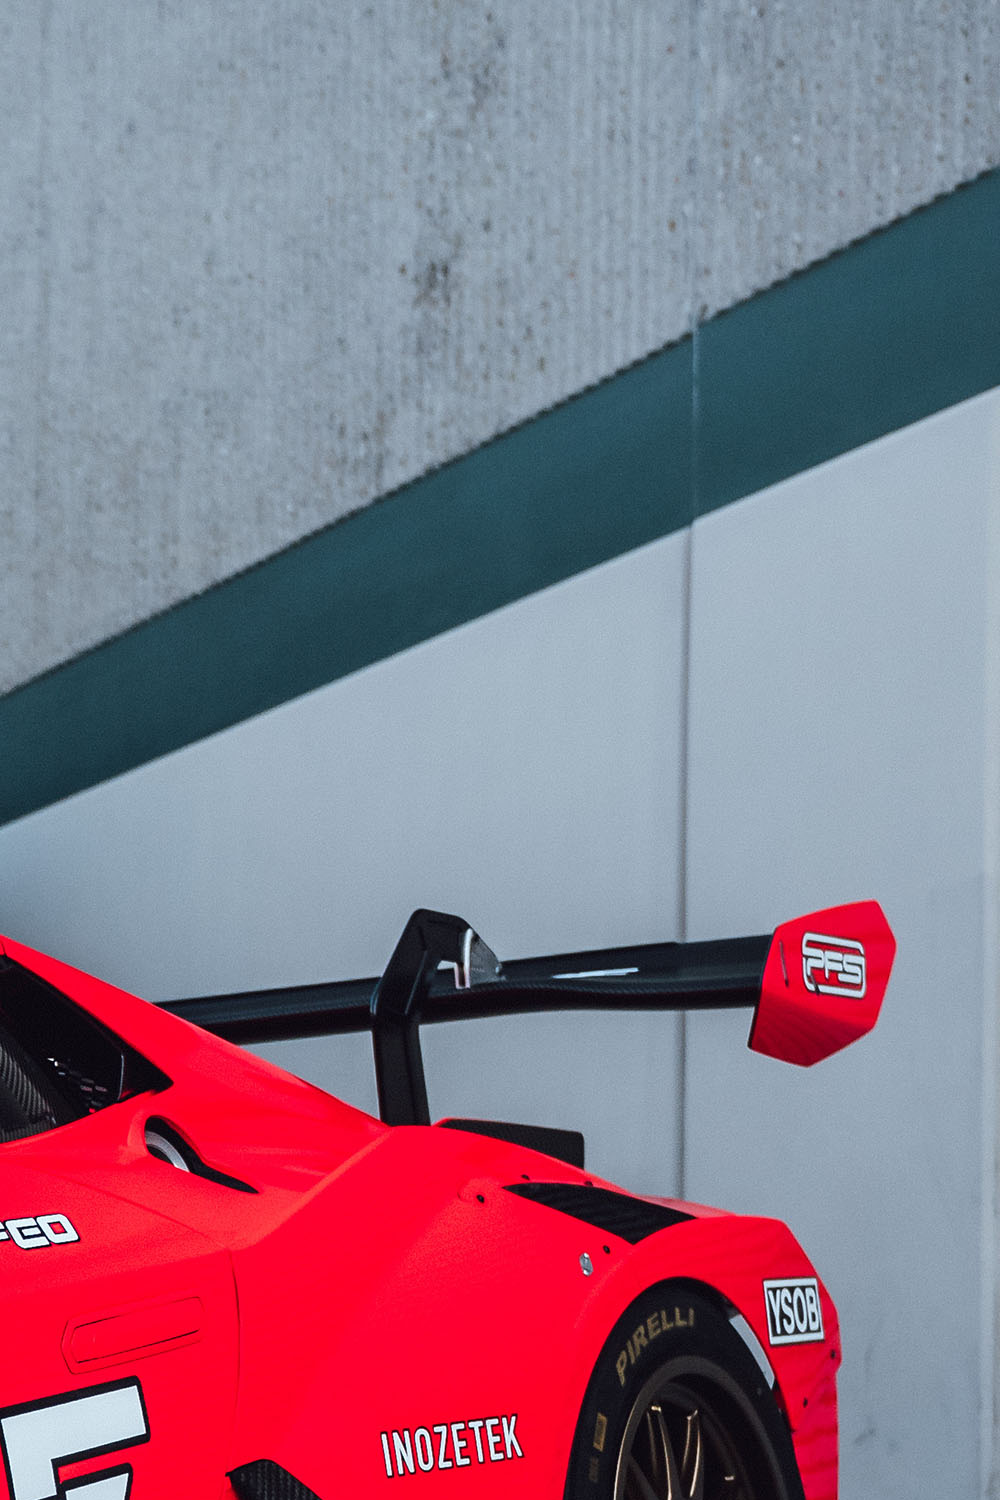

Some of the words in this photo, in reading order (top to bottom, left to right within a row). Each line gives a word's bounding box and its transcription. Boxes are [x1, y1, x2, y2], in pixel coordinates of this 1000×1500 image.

[768, 1284, 819, 1334] YSOB
[615, 1306, 695, 1387] PIRELLI
[380, 1413, 524, 1478] INOZETEK
